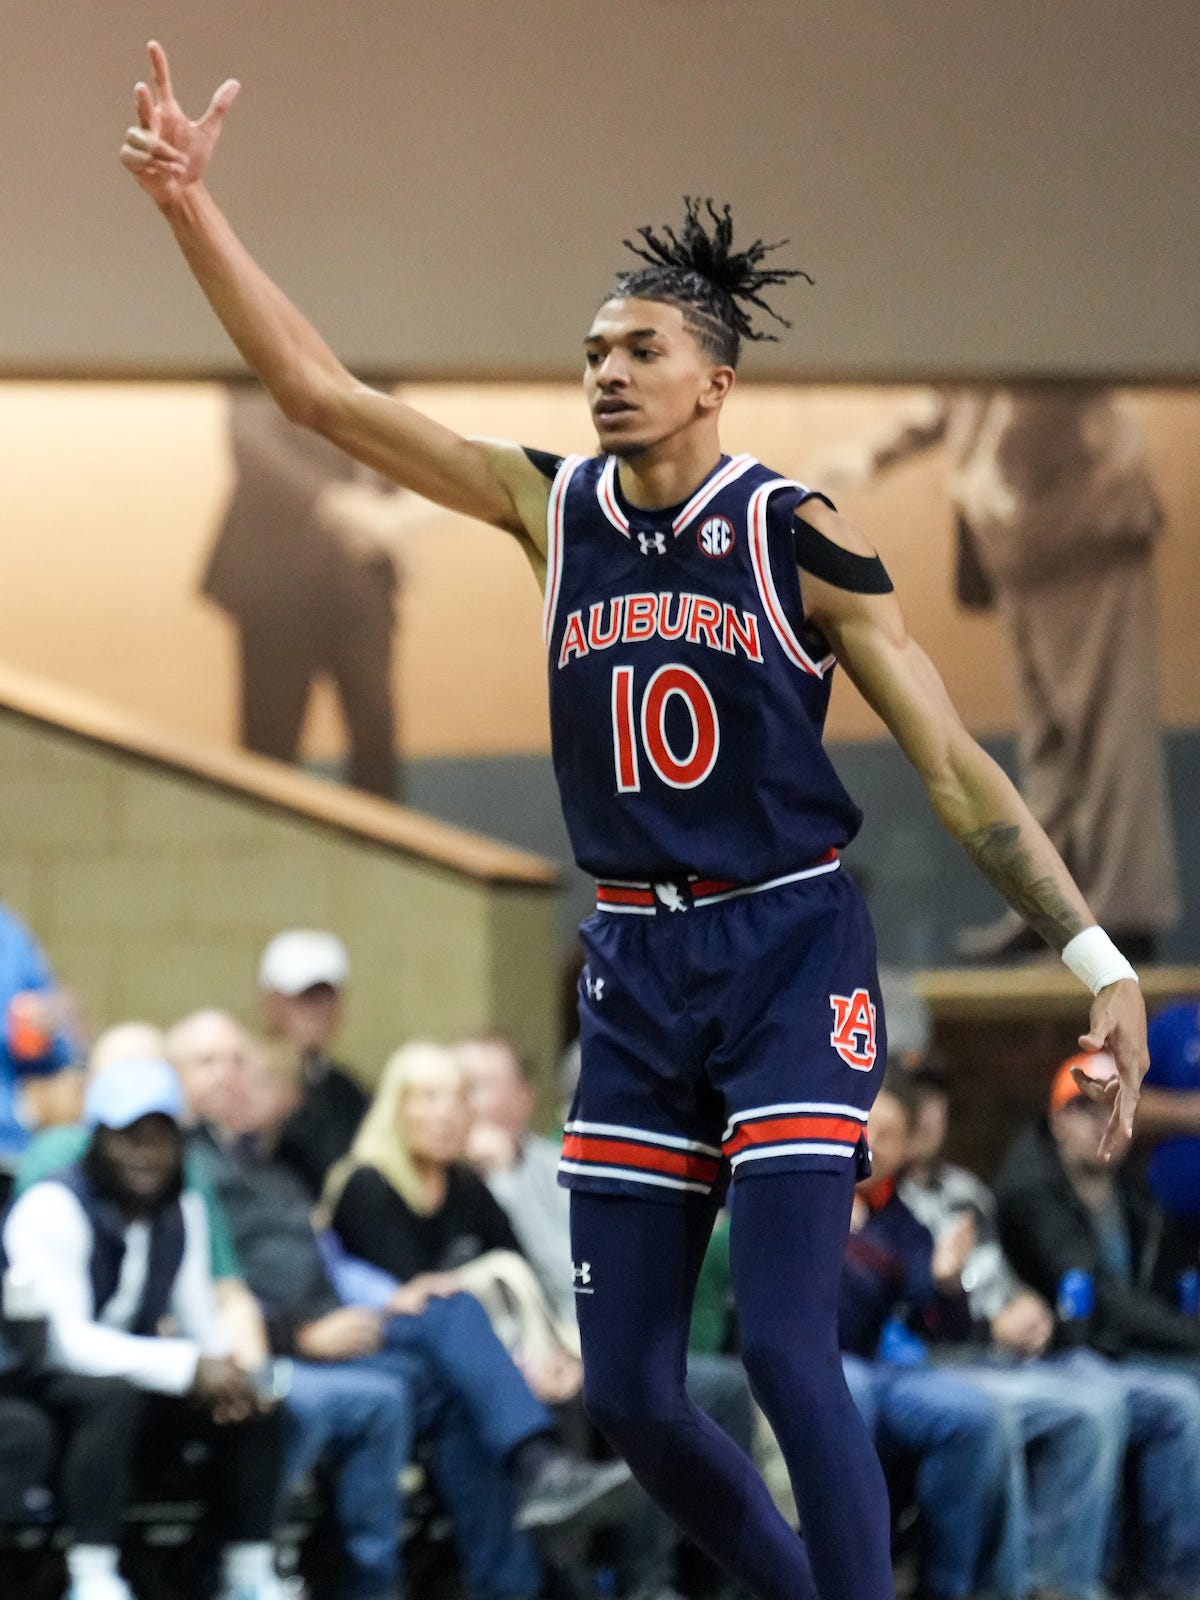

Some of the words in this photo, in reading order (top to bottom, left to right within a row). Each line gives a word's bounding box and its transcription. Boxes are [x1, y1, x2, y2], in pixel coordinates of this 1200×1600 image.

[700, 517, 731, 556] SEC
[558, 591, 764, 670] AUBURN
[611, 663, 720, 793] 10
